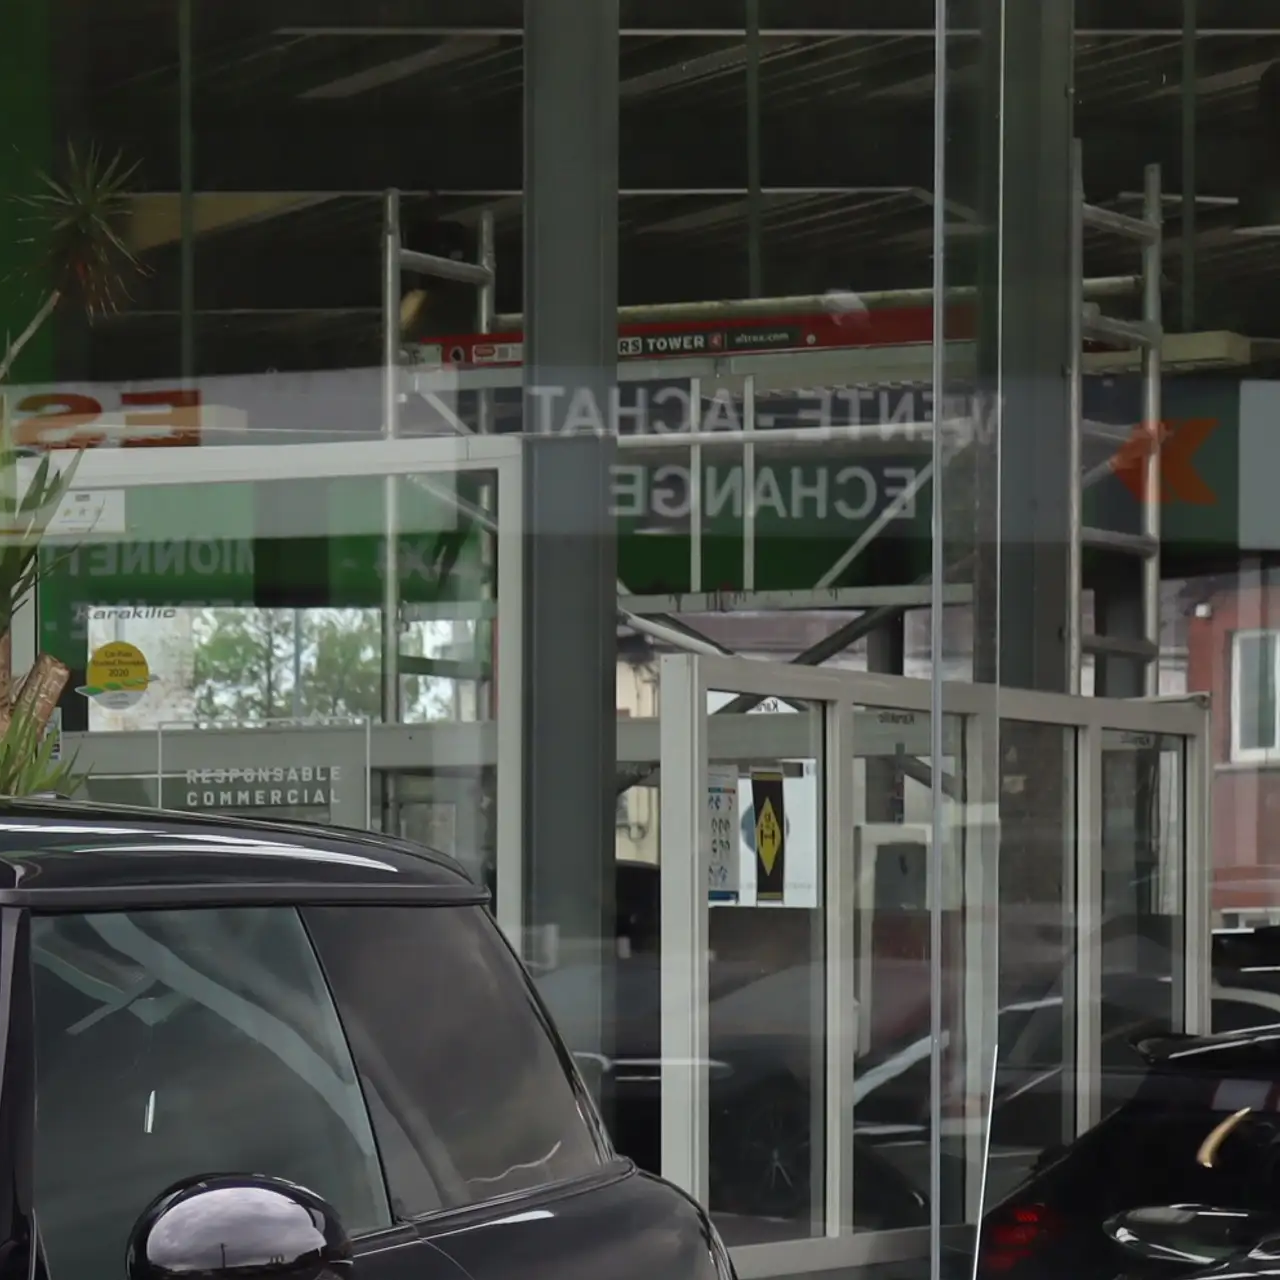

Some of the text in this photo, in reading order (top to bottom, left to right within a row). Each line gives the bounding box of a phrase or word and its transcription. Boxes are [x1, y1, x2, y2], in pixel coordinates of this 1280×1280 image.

[646, 334, 705, 351] TOWER
[186, 766, 342, 784] RESPONSABLE
[186, 789, 341, 806] COMMERCIAL
